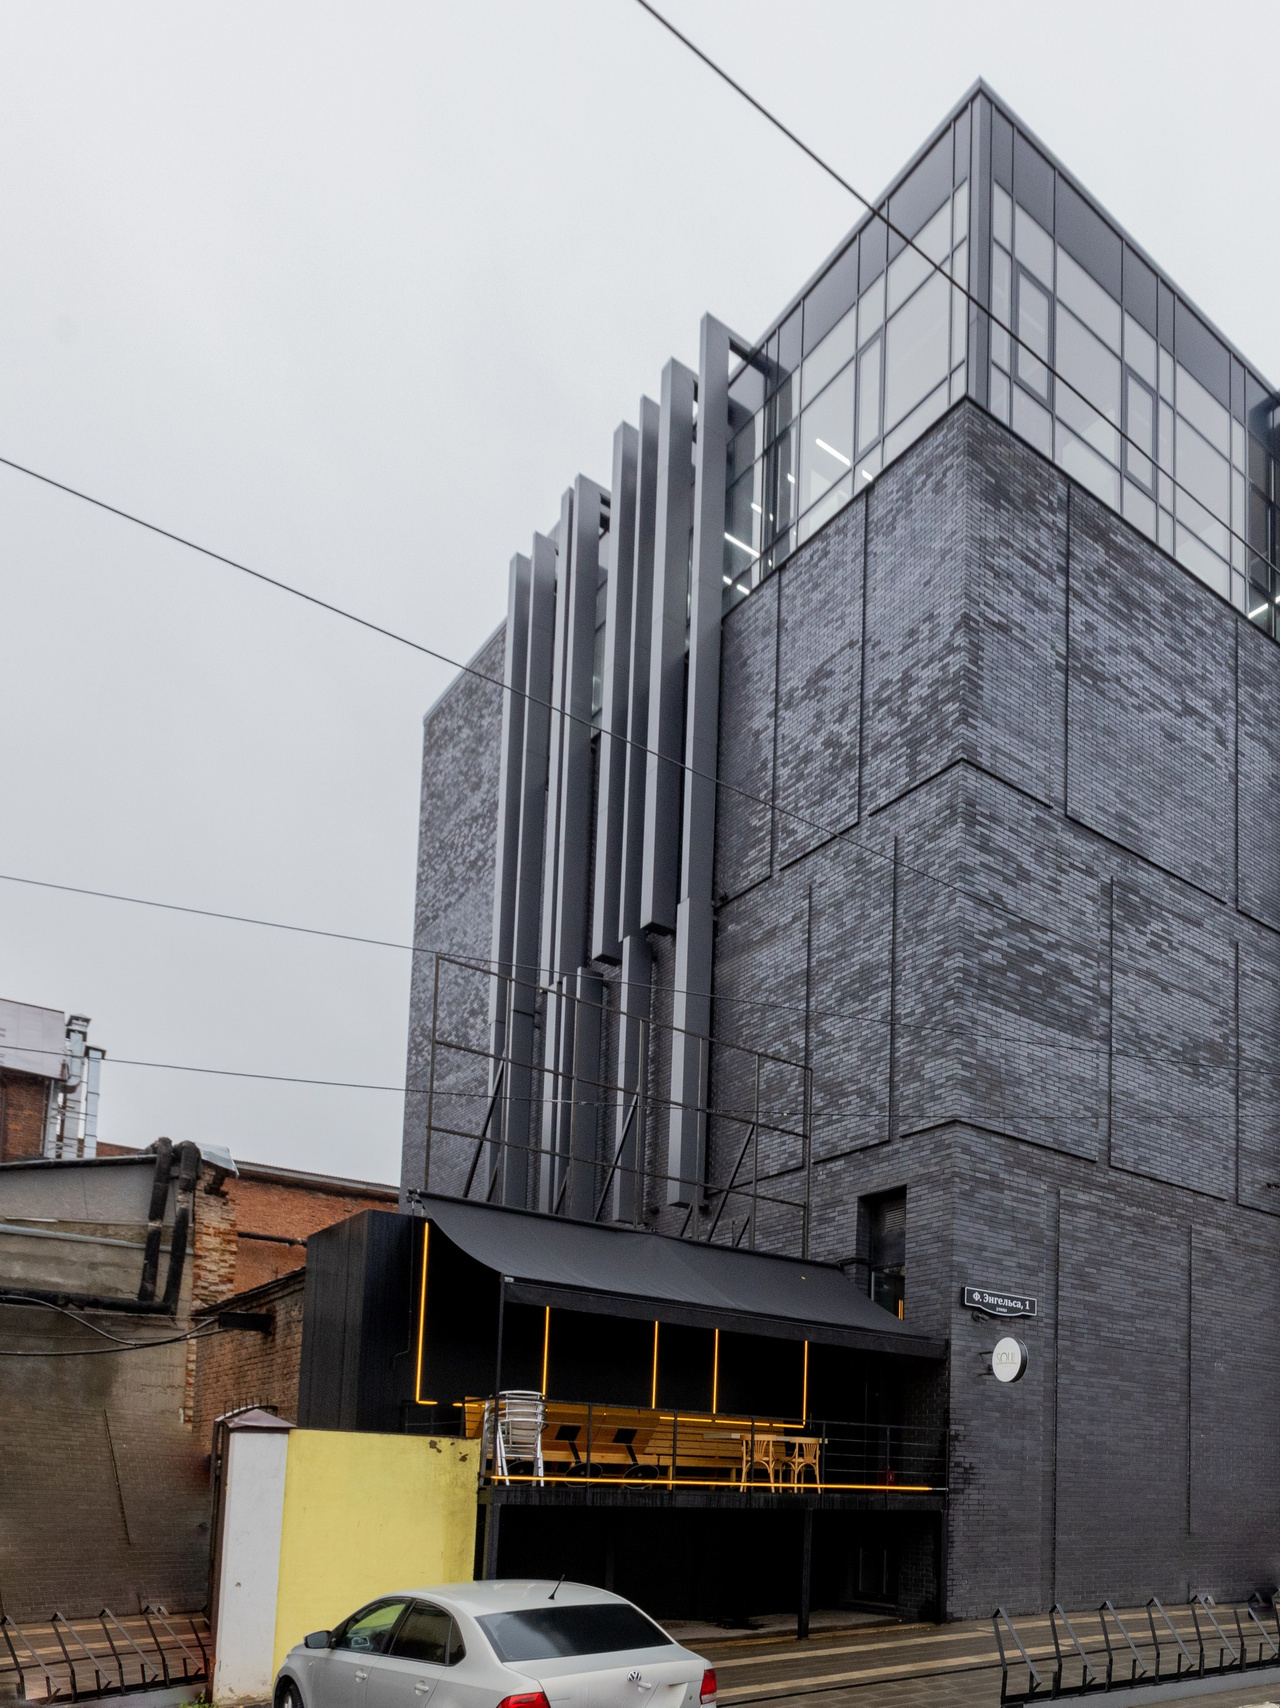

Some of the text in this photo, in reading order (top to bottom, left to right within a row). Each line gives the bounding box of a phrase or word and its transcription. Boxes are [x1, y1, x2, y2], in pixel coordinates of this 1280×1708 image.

[973, 1292, 1030, 1310] Ф. Энгельса, 1
